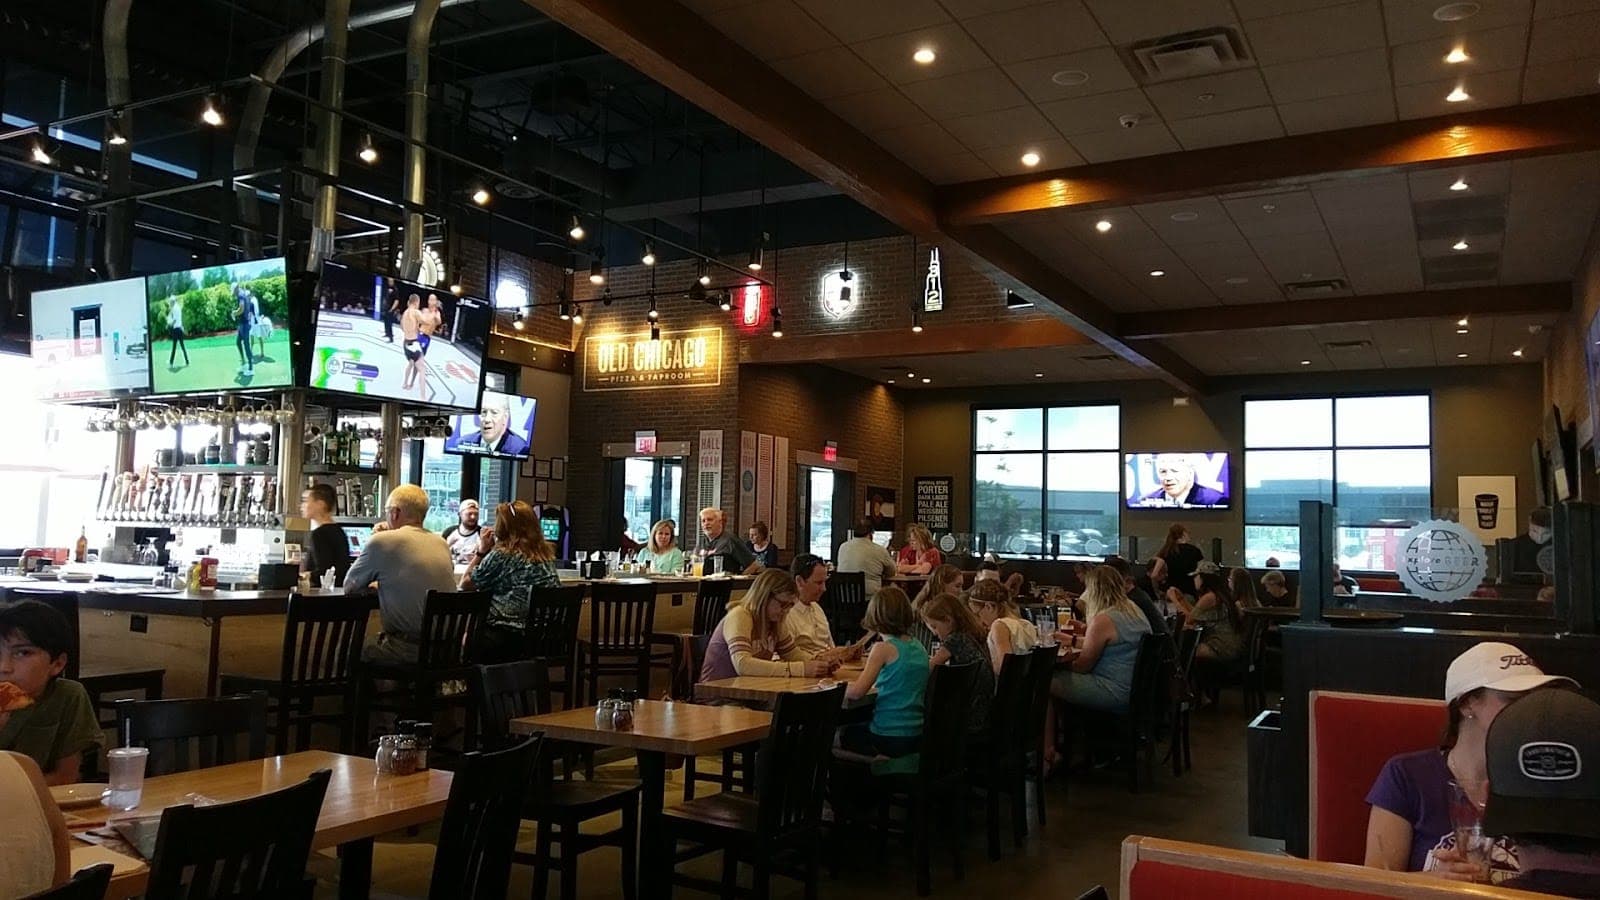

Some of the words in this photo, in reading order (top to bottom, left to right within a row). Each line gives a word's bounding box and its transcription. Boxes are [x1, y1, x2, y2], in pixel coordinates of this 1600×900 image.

[598, 343, 628, 373] OLD
[633, 337, 706, 371] CHICAGO
[610, 375, 636, 383] PIZZA
[647, 372, 691, 381] TAPROOM
[918, 485, 949, 494] PORTER
[918, 500, 934, 508] PALE
[935, 500, 949, 508] ALE
